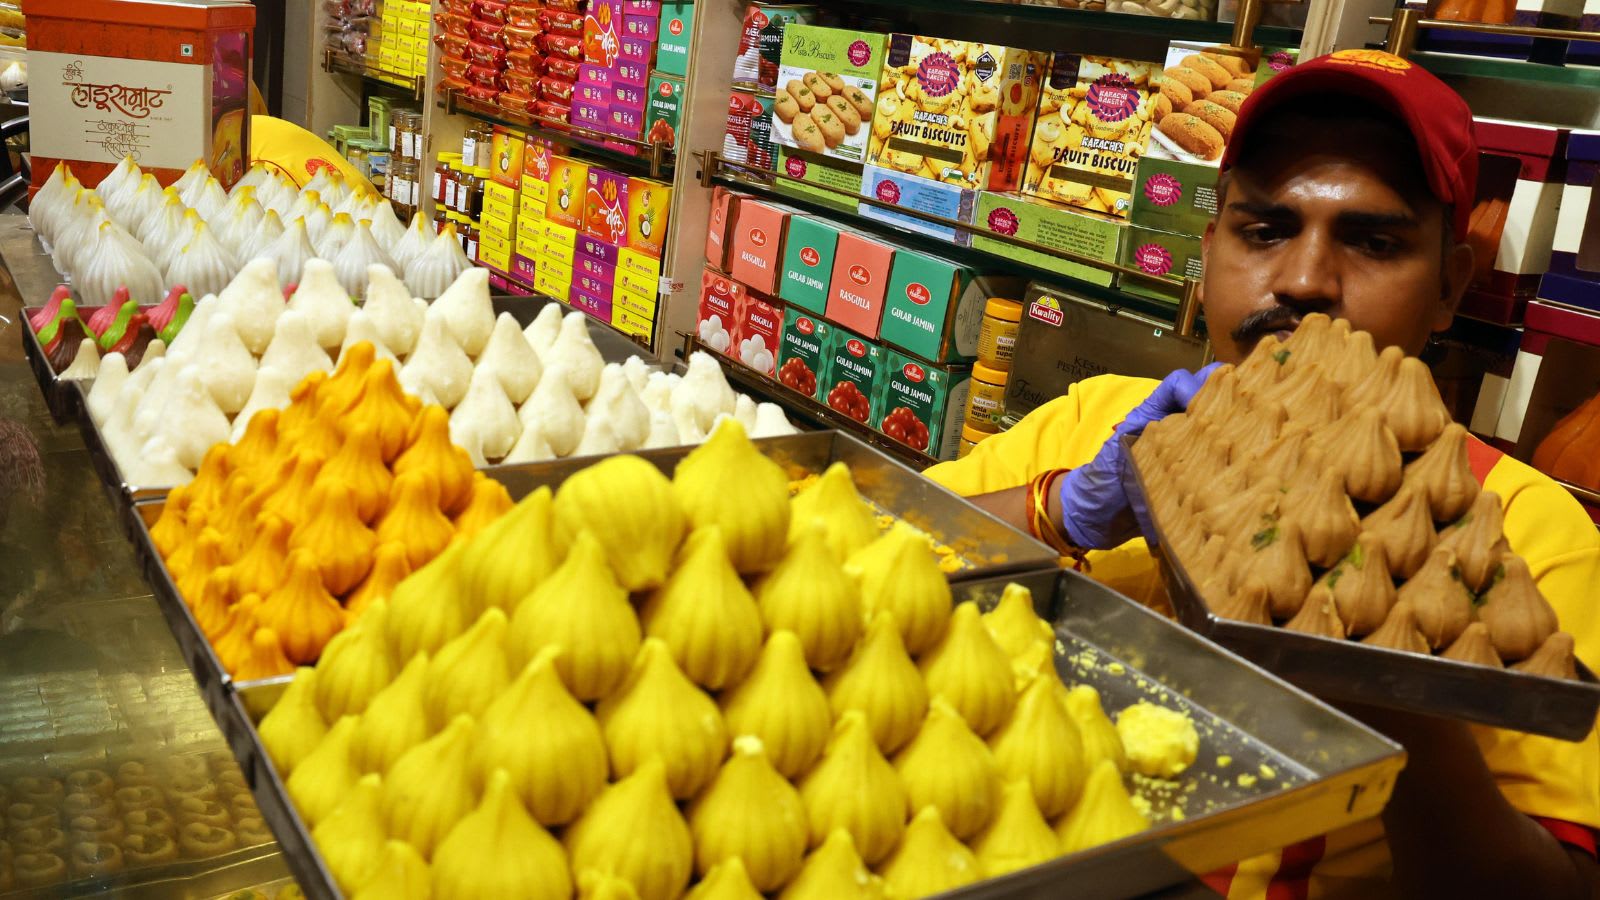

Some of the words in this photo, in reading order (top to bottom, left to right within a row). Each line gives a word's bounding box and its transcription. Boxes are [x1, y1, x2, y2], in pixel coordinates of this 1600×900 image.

[927, 68, 949, 76] KARACHI
[927, 74, 947, 82] BAKERY
[1098, 96, 1124, 106] BAKERY
[1100, 90, 1128, 100] KARACHI
[913, 110, 949, 126] KARACHI'S
[891, 120, 920, 137] FRUIT
[922, 125, 966, 146] BISCUITS
[1081, 136, 1124, 154] KARACHI'S
[1053, 146, 1090, 165] FRUIT
[1092, 154, 1137, 174] BISCUIT
[742, 250, 766, 269] RASGULLA
[788, 270, 806, 284] GULAB
[806, 276, 824, 290] JAMUN
[708, 294, 728, 310] RASGULLA
[840, 289, 870, 310] RASGULLA
[750, 313, 772, 330] RASGULLA
[891, 307, 912, 323] GULAB
[912, 316, 935, 334] JAMUN
[1032, 304, 1060, 323] Kwality
[786, 333, 801, 346] GULAB
[802, 340, 818, 354] JAMUN
[836, 356, 852, 368] GULAB
[852, 362, 872, 378] JAMUN
[892, 380, 910, 394] GULAB
[910, 388, 932, 404] JAMUN
[971, 410, 990, 419] supari
